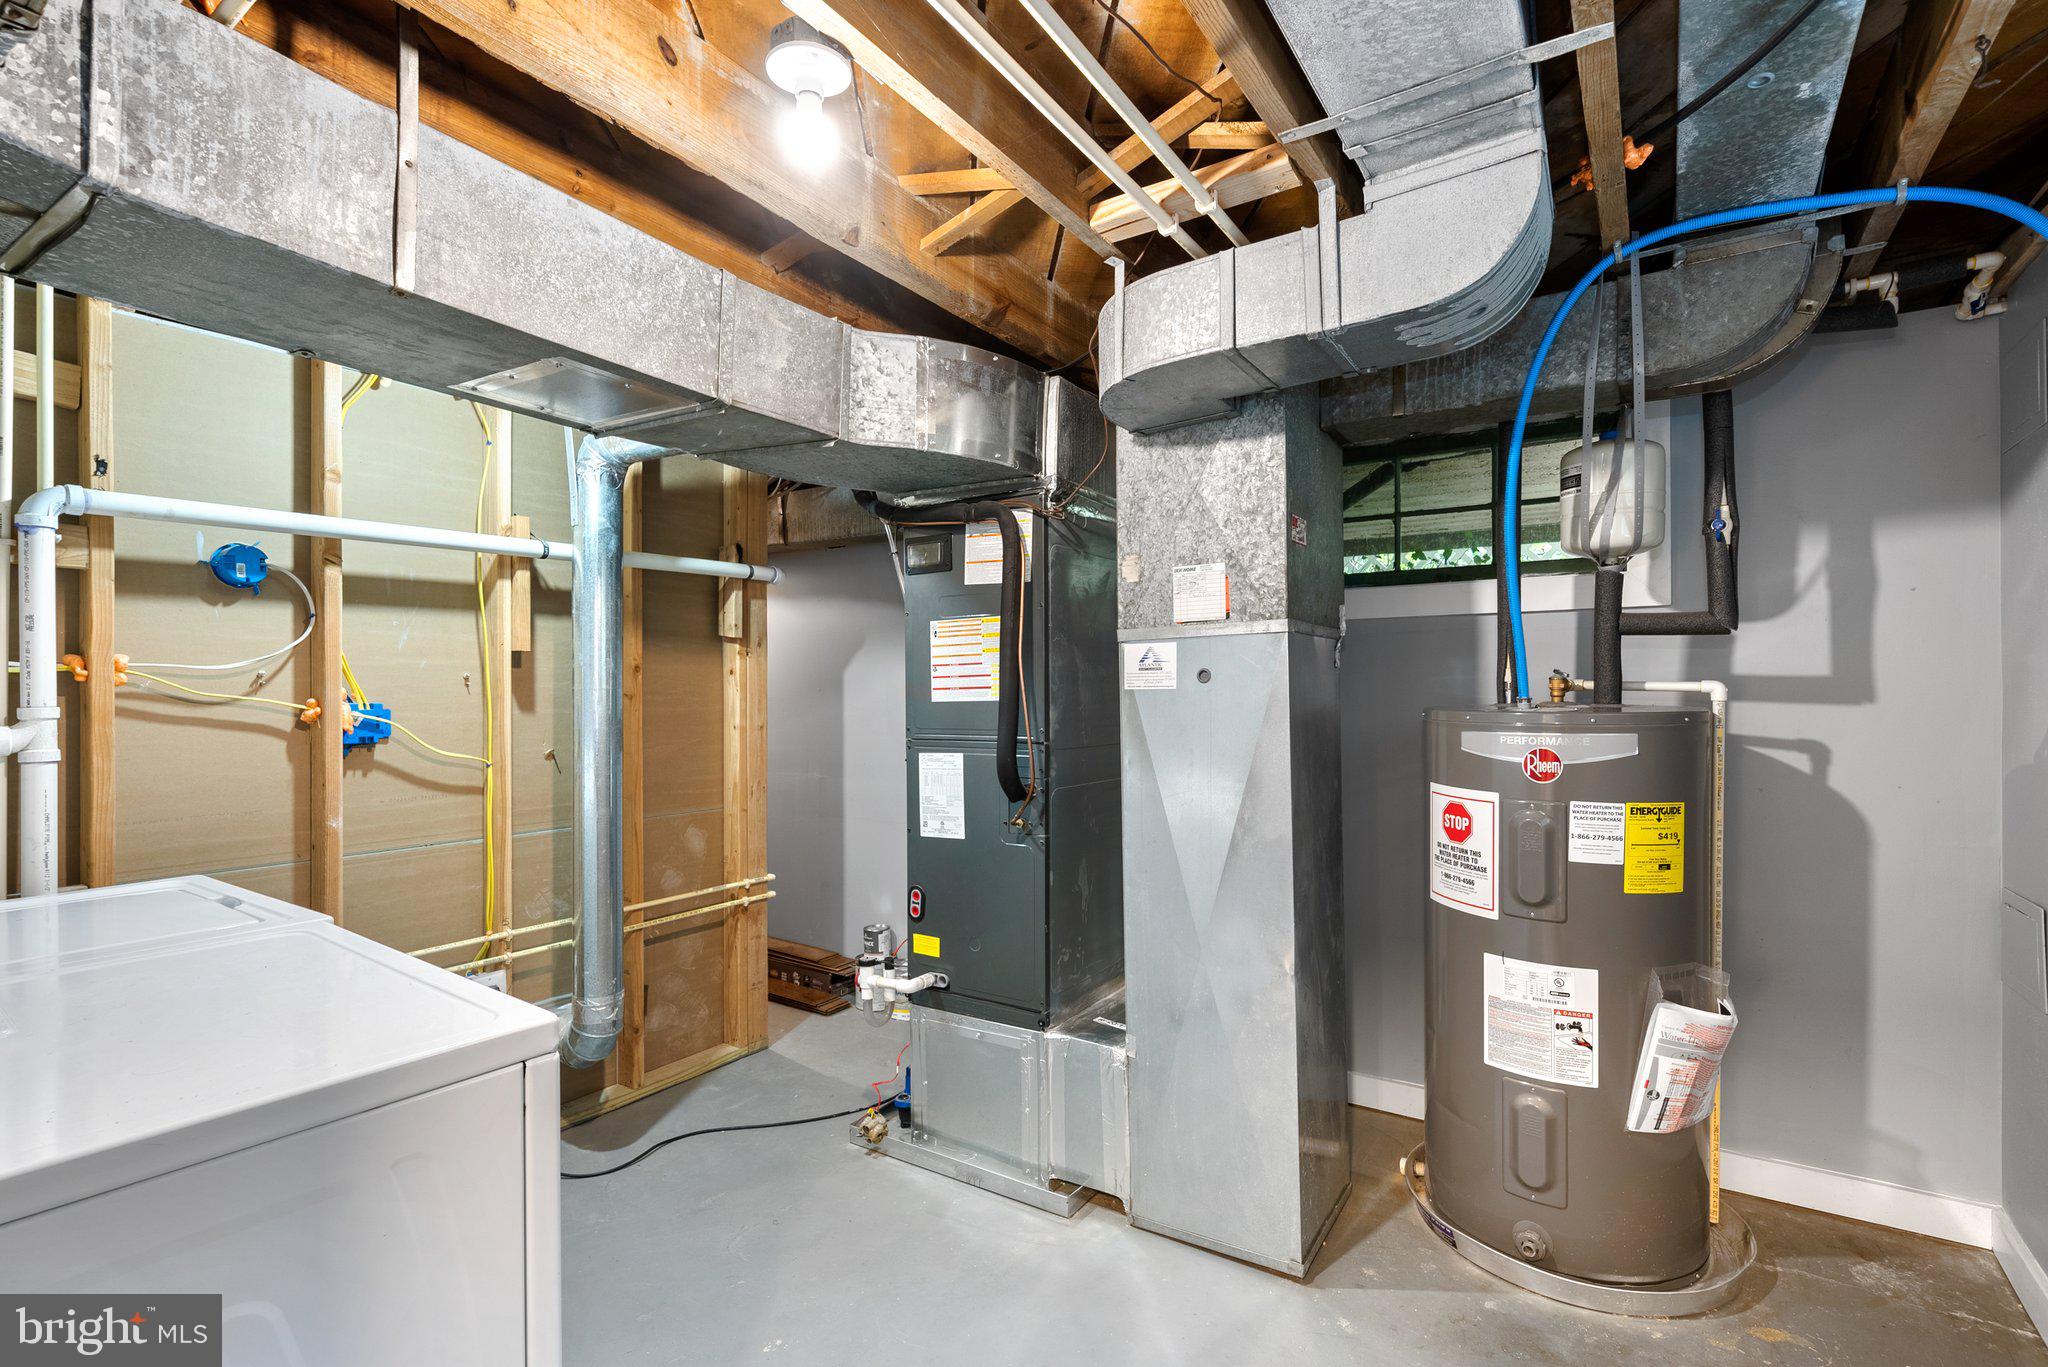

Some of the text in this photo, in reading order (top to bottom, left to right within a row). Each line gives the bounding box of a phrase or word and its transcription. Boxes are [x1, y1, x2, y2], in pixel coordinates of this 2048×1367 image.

[1527, 748, 1560, 777] Rheem
[1630, 806, 1682, 816] ENERGYGUIDE
[1444, 814, 1470, 831] STOP
[1571, 833, 1623, 842] 1-866-279-4566
[1658, 832, 1678, 840] $419
[1439, 849, 1451, 858] WATER
[1452, 852, 1470, 862] HEATER
[1451, 845, 1468, 854] RETURN
[1470, 850, 1481, 858] THIS
[1441, 855, 1452, 865] PLACE
[1460, 862, 1487, 873] PURCHASE
[1441, 871, 1475, 886] 1-866-279-4566
[1563, 1010, 1591, 1018] DANGER
[1661, 1030, 1684, 1042] Water
